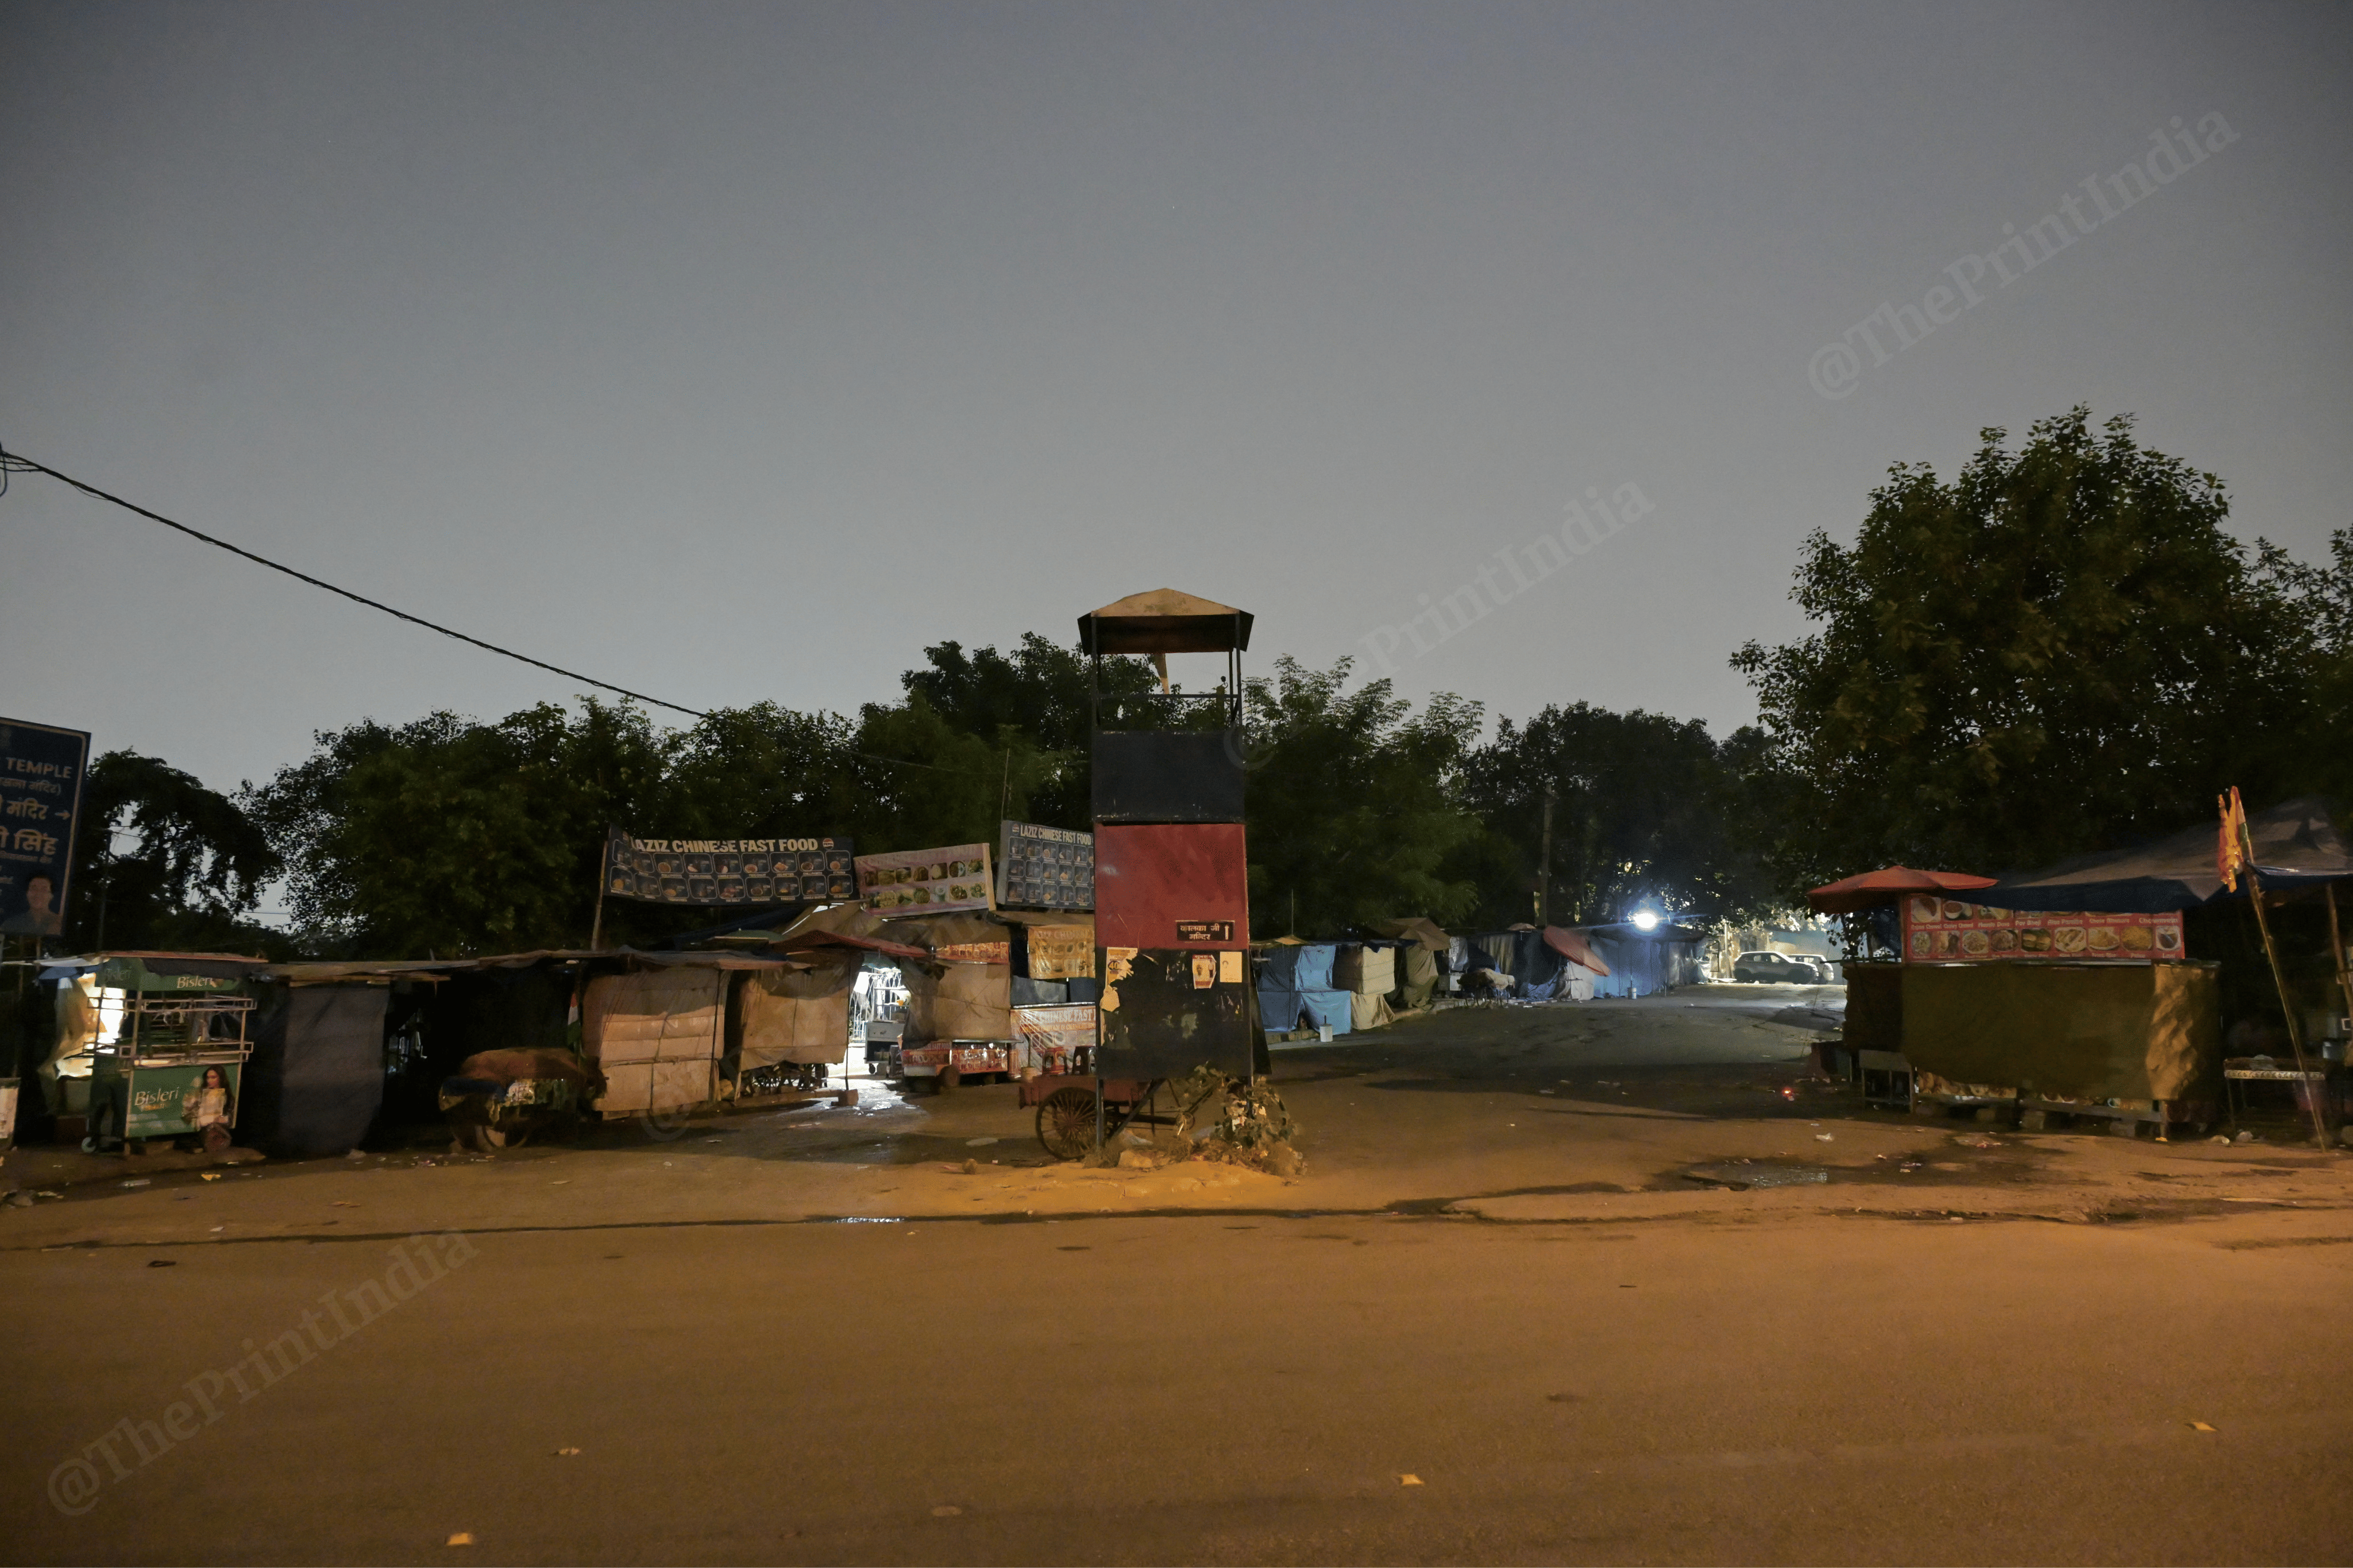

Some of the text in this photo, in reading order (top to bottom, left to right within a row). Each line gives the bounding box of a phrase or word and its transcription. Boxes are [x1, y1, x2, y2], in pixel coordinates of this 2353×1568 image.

[6, 757, 72, 778] TEMPLE
[6, 797, 49, 820] मंदिर
[13, 828, 59, 855] सिंह
[1020, 824, 1091, 845] LAZIZ CHINESE FAST FOOD
[672, 839, 738, 853] CHINESE
[739, 839, 776, 852] FAST
[778, 838, 819, 852] FOOD
[1210, 923, 1220, 932] जी
[1074, 1008, 1093, 1022] FAST
[134, 1087, 180, 1106] Bisleri
